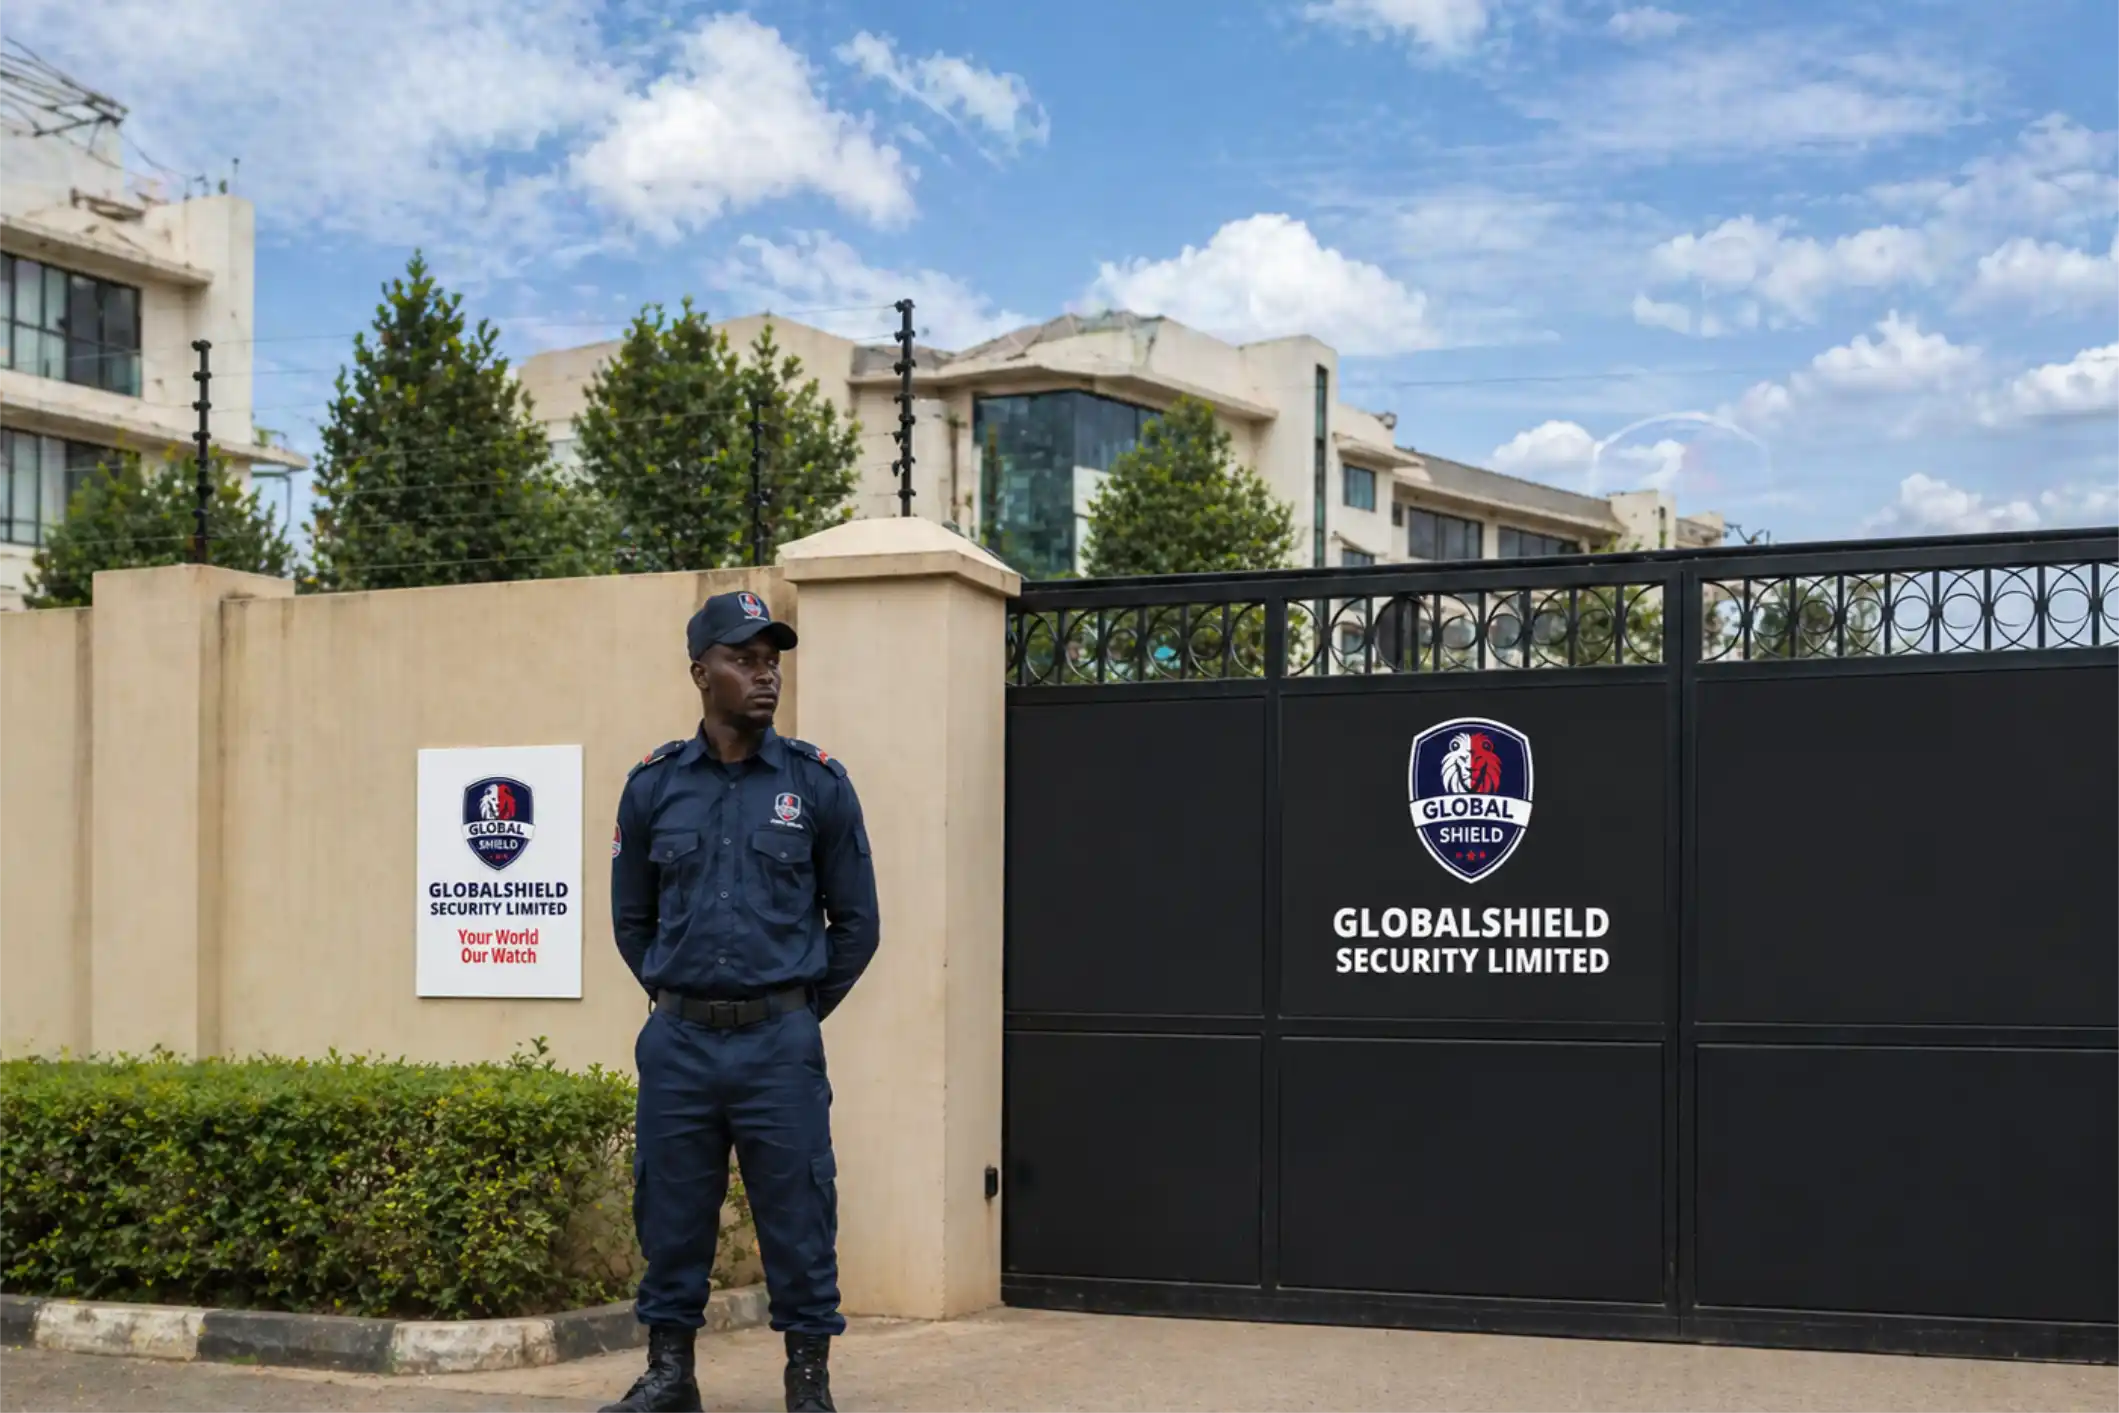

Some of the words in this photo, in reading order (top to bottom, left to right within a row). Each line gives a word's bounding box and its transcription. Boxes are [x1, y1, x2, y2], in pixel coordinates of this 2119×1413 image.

[1422, 798, 1514, 819] GLOBAL
[469, 822, 524, 836] GLOBAL
[1440, 827, 1503, 843] SHIELD
[429, 882, 568, 898] GLOBALSHIELD
[430, 902, 502, 915] SECURITY
[507, 902, 567, 915] LIMITED
[1334, 908, 1610, 938] GLOBALSHIELD
[457, 929, 492, 945] Your
[496, 928, 539, 945] World
[461, 948, 488, 964] Our
[492, 948, 536, 964] Watch
[1336, 947, 1479, 973] SECURITY
[1488, 947, 1610, 973] LIMITED
